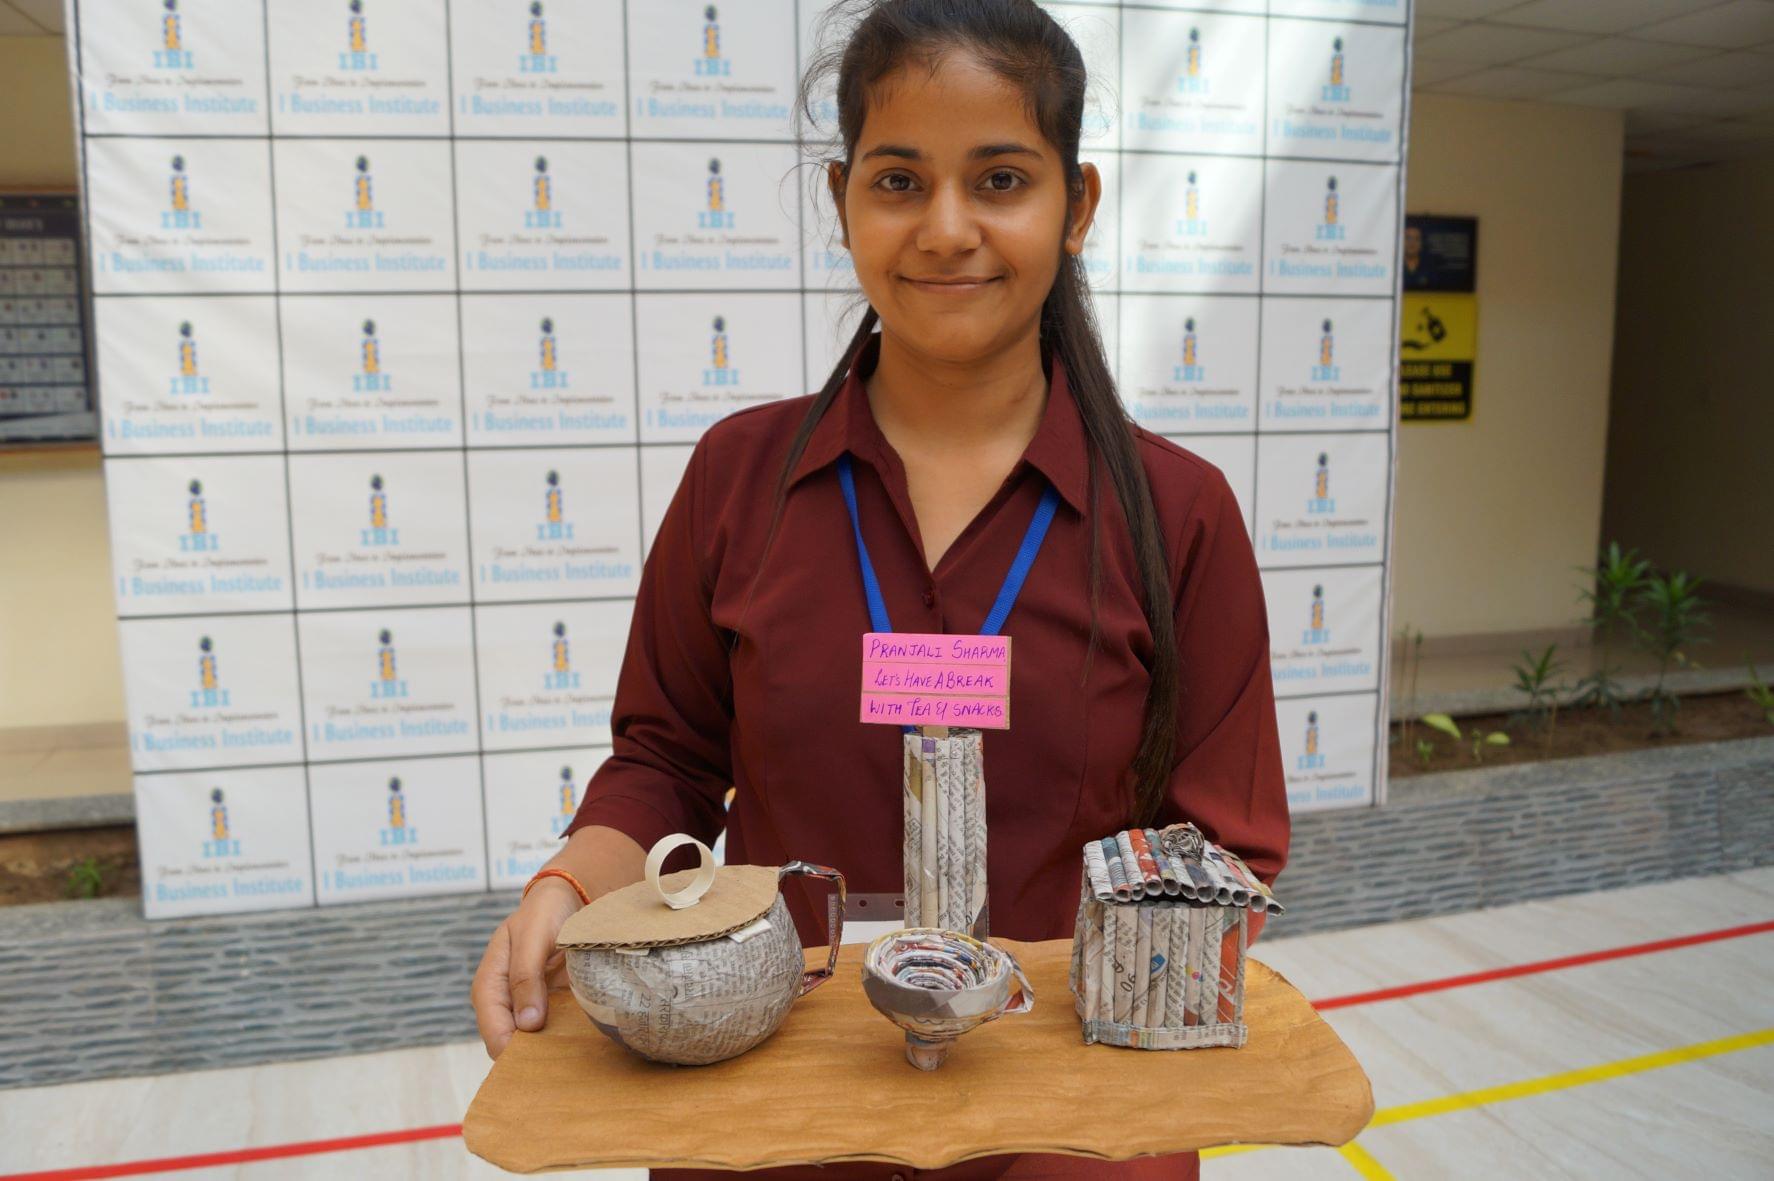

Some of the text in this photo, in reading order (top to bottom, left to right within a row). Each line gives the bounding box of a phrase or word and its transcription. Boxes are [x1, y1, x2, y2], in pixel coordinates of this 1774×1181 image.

[103, 92, 178, 112] Business
[184, 94, 257, 112] Institute
[291, 93, 362, 113] Business
[368, 95, 439, 113] Institute
[471, 95, 542, 114] Business
[547, 97, 616, 115] Institute
[648, 96, 715, 117] Business
[720, 99, 788, 117] Institute
[1283, 120, 1335, 139] Business
[1341, 124, 1391, 143] Institute
[111, 252, 184, 271] Business
[191, 253, 263, 271] Institute
[298, 251, 370, 270] Business
[374, 253, 445, 271] Institute
[478, 252, 546, 270] Business
[552, 252, 622, 269] Institute
[653, 250, 720, 269] Business
[725, 251, 790, 269] Institute
[1136, 255, 1191, 274] Business
[1198, 257, 1252, 275] Institute
[1279, 258, 1331, 277] Business
[1337, 260, 1385, 278] Institute
[1134, 400, 1247, 419] Business Institute
[1275, 400, 1324, 417] Business
[1330, 400, 1380, 416] Institute
[120, 418, 194, 437] Business
[201, 416, 272, 436] Institute
[305, 415, 376, 434] Business
[381, 414, 453, 432] Institute
[484, 410, 552, 429] Business
[558, 410, 627, 428] Institute
[1271, 532, 1321, 551] Business
[1327, 530, 1376, 547] Institute
[314, 568, 384, 588] Business
[390, 566, 460, 585] Institute
[491, 561, 559, 582] Business
[564, 559, 630, 579] Institute
[131, 574, 204, 594] Business
[210, 573, 282, 592] Institute
[869, 639, 1006, 659] PRANJALI SHARMA
[874, 667, 994, 689] LET'S HAVE A BREAK
[1273, 660, 1370, 680] usiness Institute
[869, 700, 902, 715] WITH
[907, 698, 931, 717] TEA
[953, 702, 1002, 717] SNACKS
[324, 719, 395, 741] Business
[399, 716, 468, 737] Institute
[499, 710, 565, 731] Business
[143, 730, 215, 751] Business
[221, 726, 293, 746] Institute
[1316, 782, 1365, 800] Institute
[334, 865, 403, 888] Business
[408, 861, 476, 883] Institute
[156, 878, 227, 901] Business
[233, 873, 302, 896] Institute
